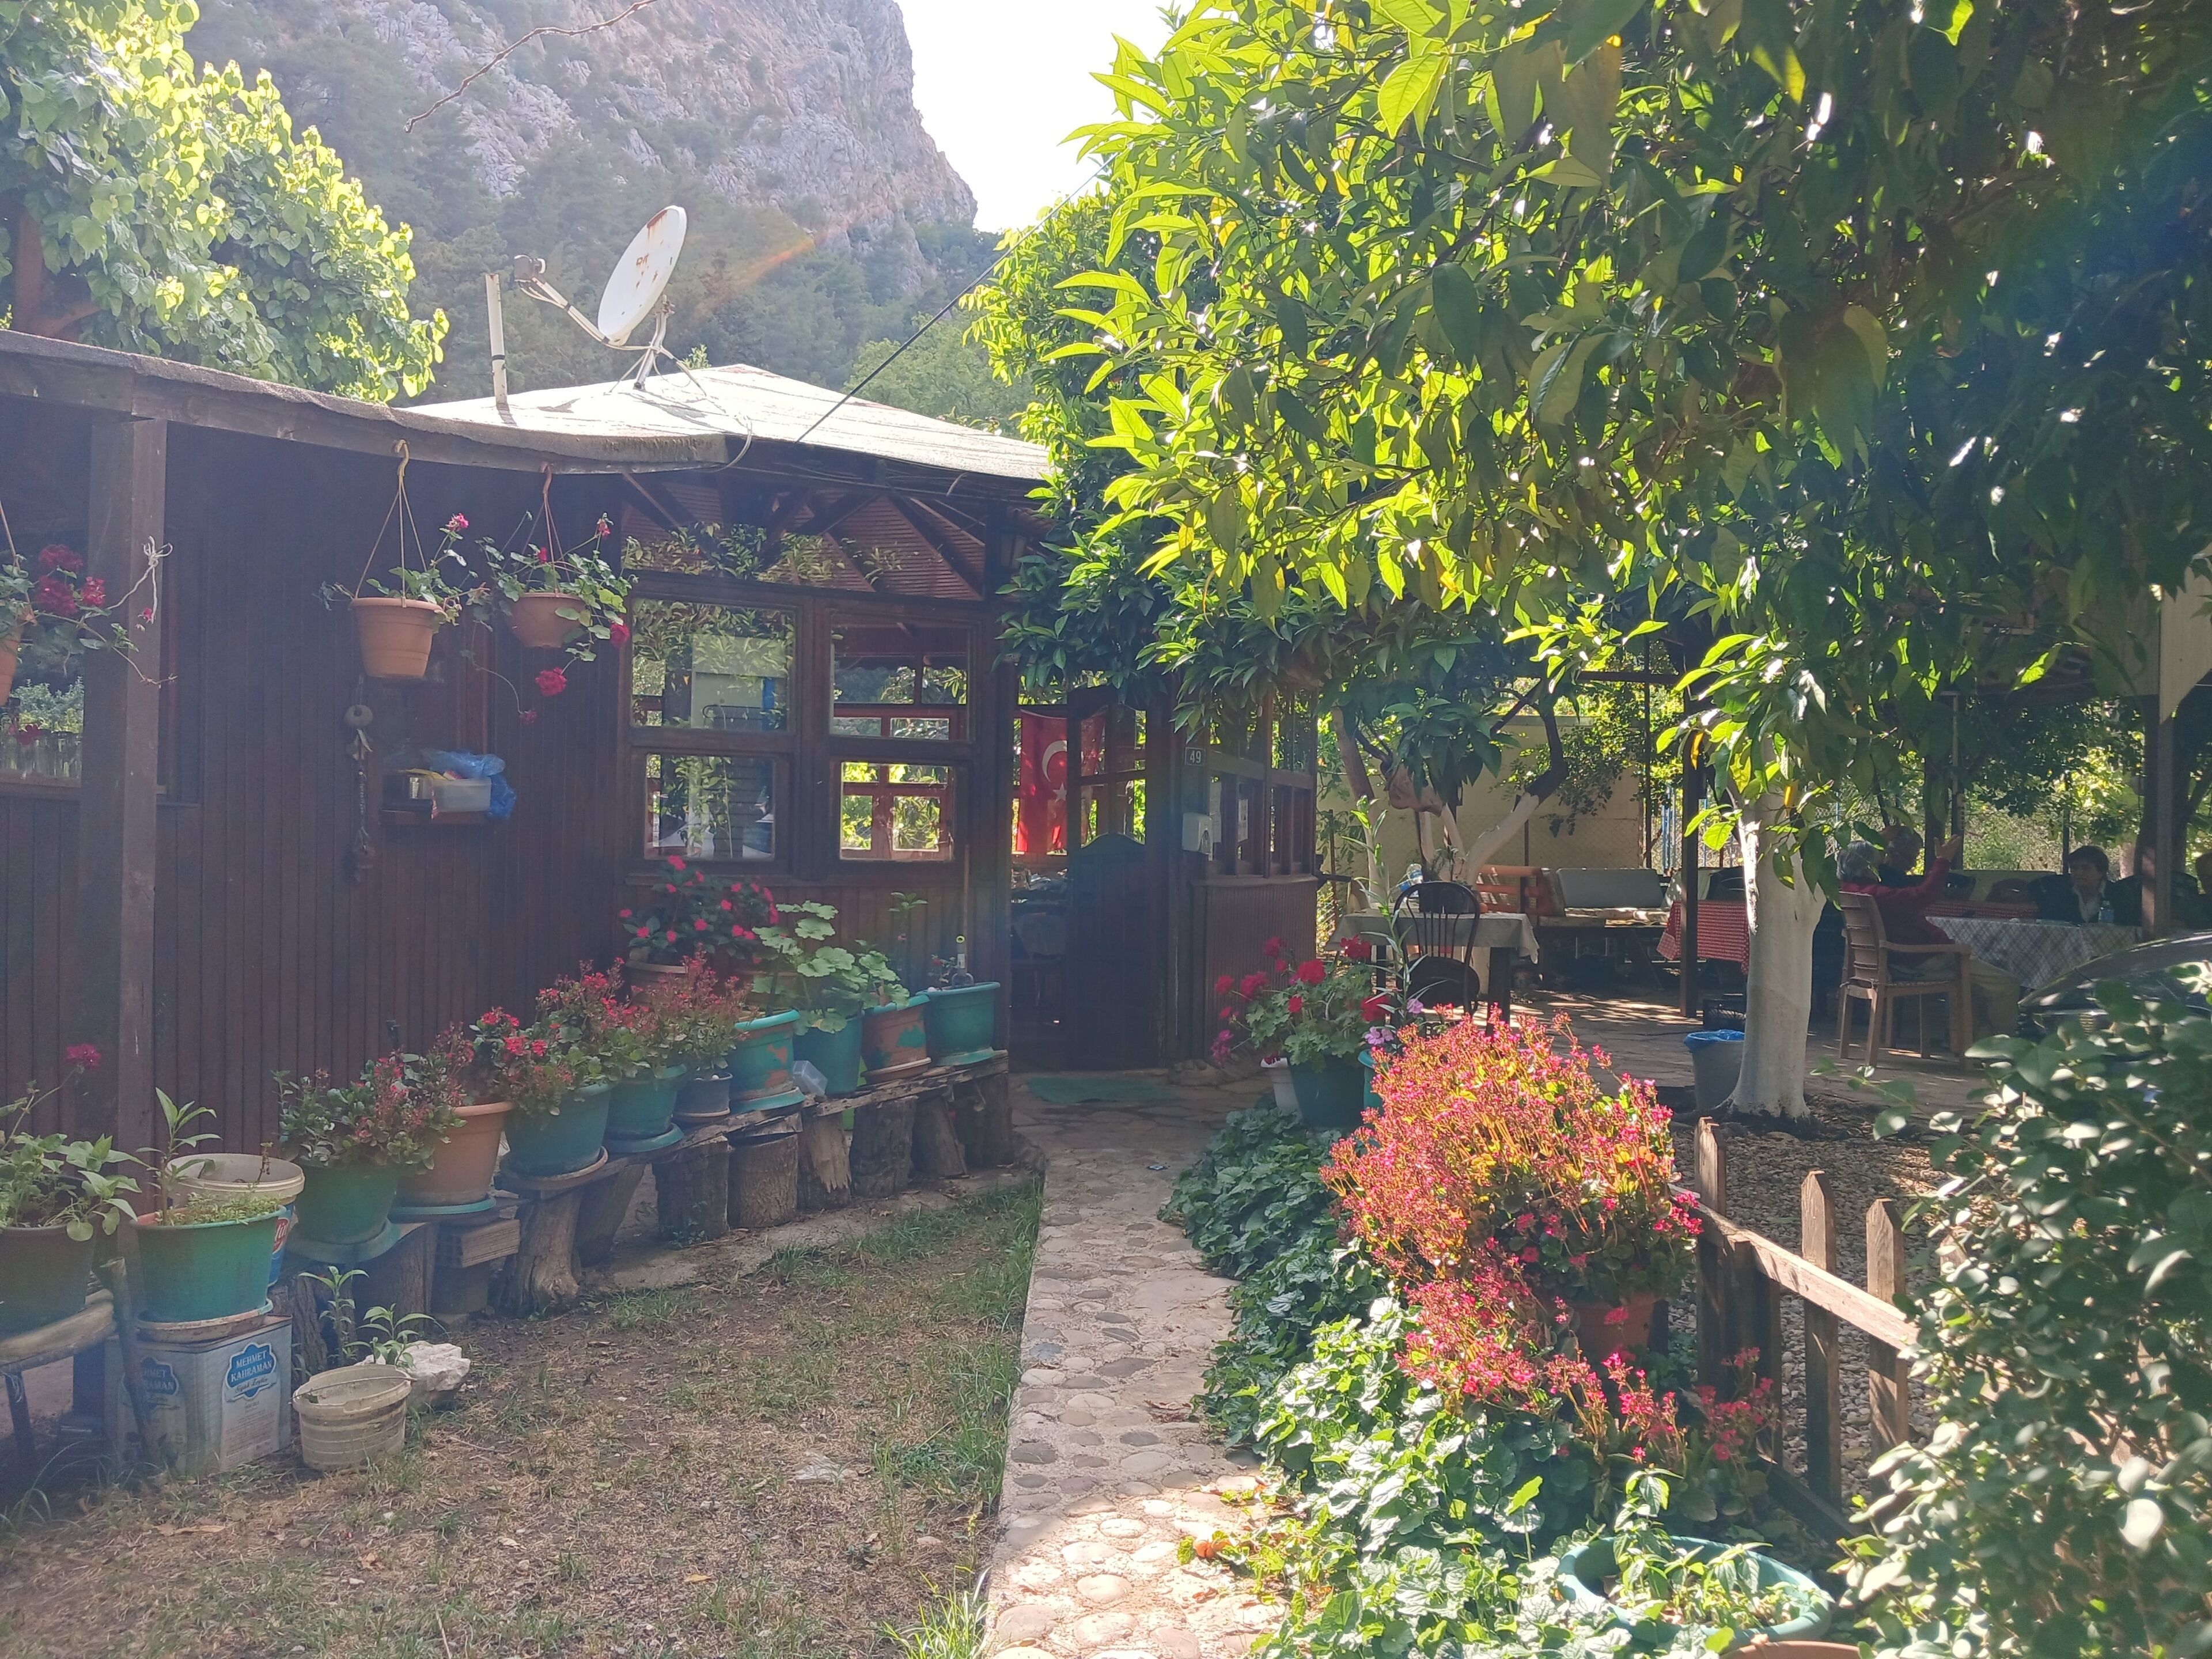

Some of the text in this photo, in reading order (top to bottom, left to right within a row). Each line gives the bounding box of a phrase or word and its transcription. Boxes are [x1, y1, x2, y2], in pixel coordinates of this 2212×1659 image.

[1190, 750, 1202, 763] 49
[236, 1350, 267, 1369] MEHMET
[231, 1360, 272, 1382] KAHRAMAN
